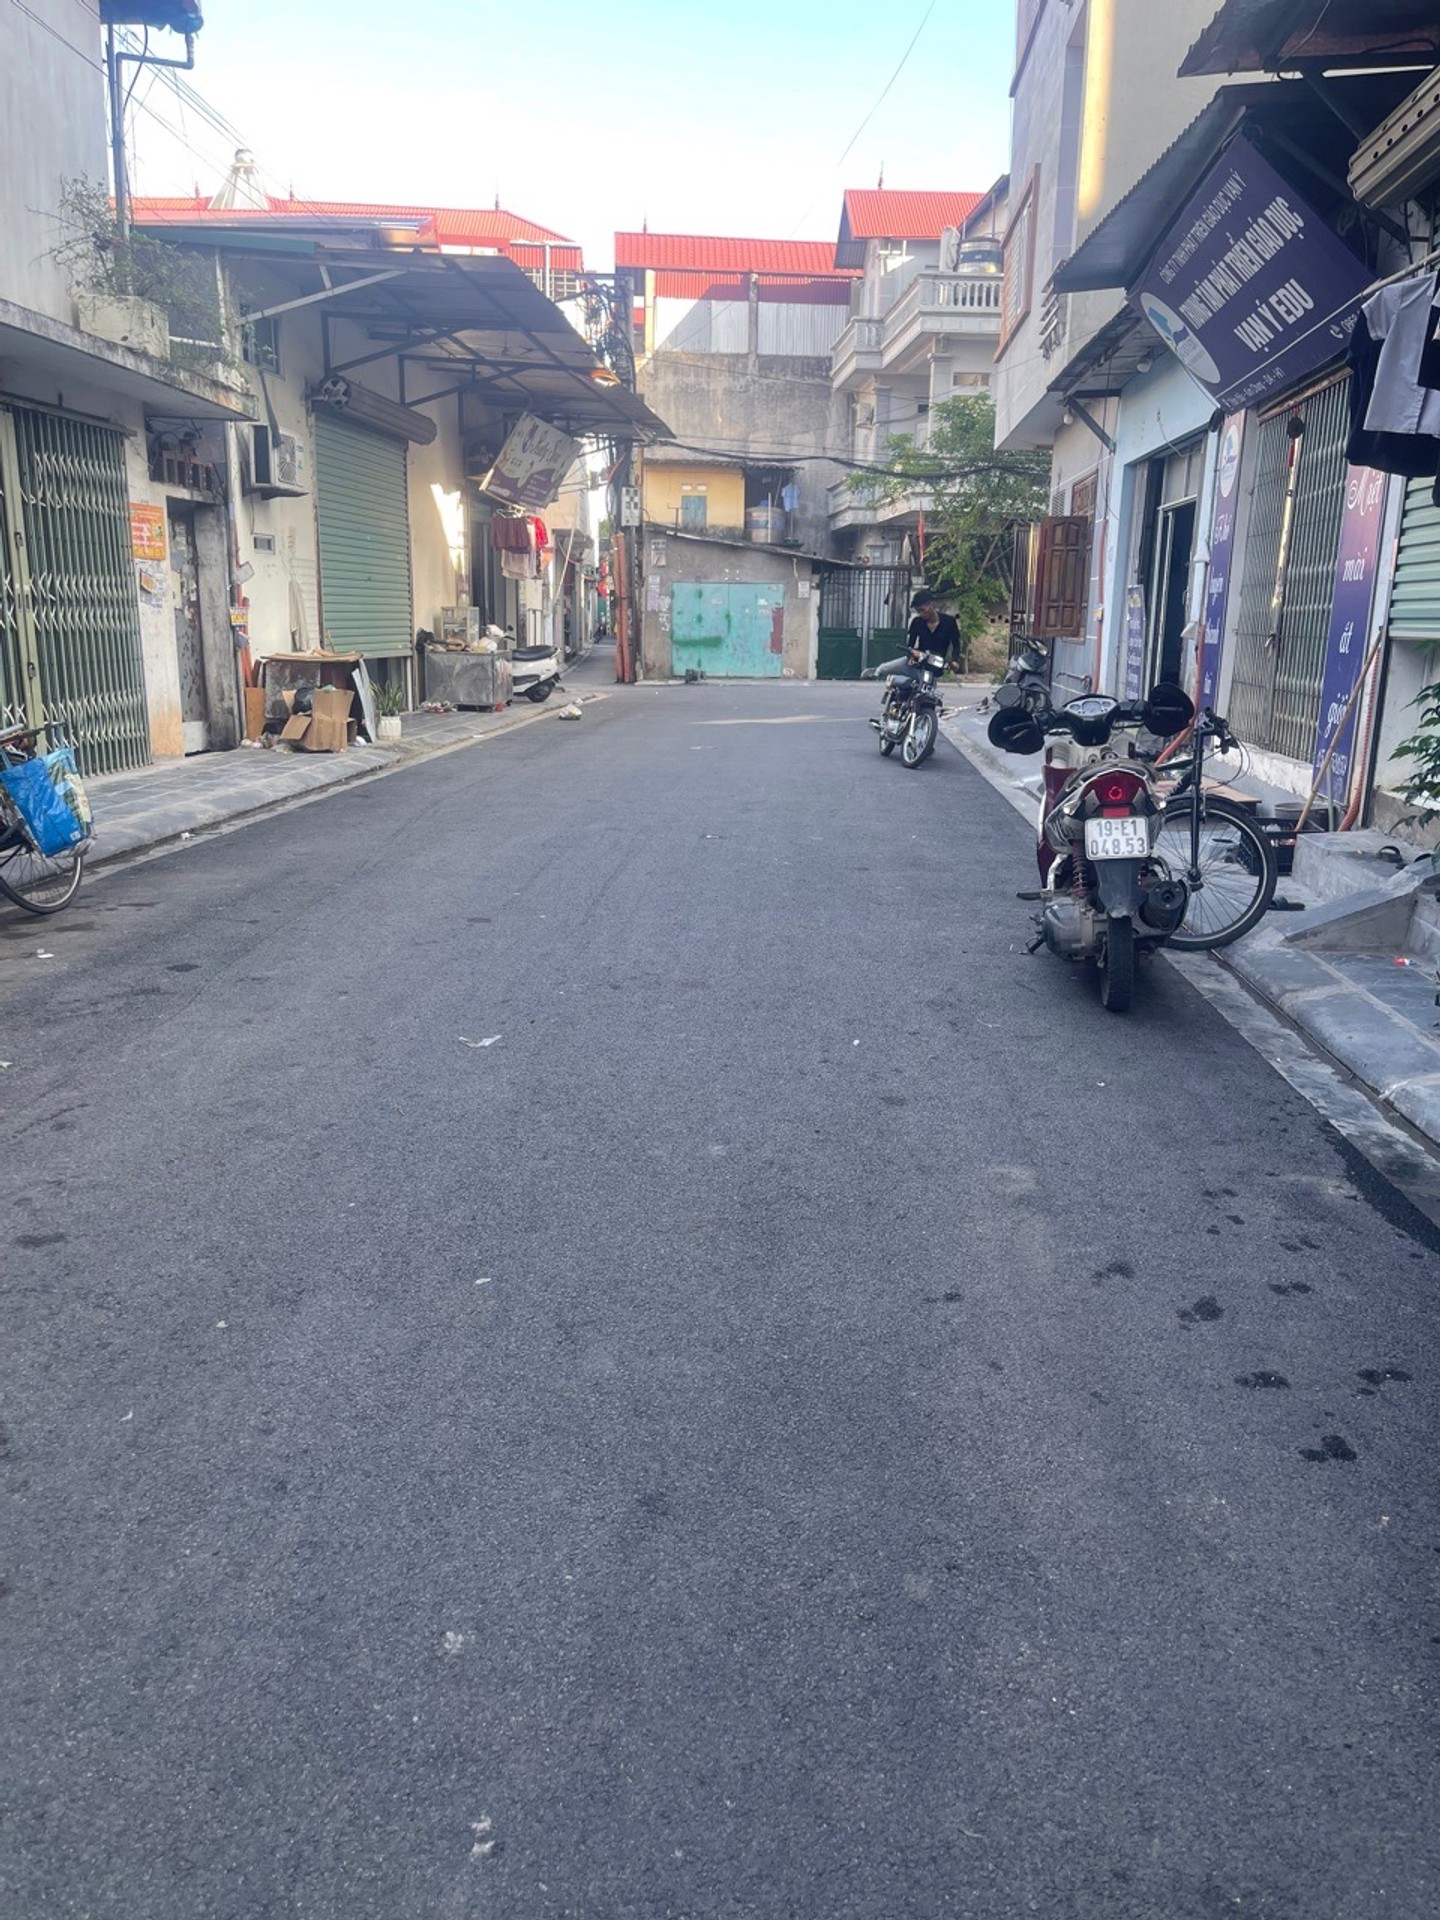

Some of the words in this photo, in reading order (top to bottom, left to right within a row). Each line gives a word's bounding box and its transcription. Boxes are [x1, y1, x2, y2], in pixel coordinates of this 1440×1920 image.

[1221, 177, 1243, 200] VẠN
[1230, 168, 1246, 187] Ý
[1201, 205, 1221, 228] GIÁO
[1211, 191, 1232, 215] DỤC
[1263, 196, 1304, 240] DỤC
[1245, 216, 1285, 261] GIÁO
[1223, 231, 1265, 282] TRIỂN
[1194, 279, 1227, 313] TÂM
[1207, 259, 1243, 301] PHÁT
[1179, 293, 1213, 330] TRUNG
[1255, 298, 1284, 333] Ý
[1268, 277, 1315, 325] EDU
[1233, 312, 1275, 352] VẠN
[1342, 547, 1368, 582] mài
[1090, 837, 1146, 856] 048.53
[1096, 820, 1137, 838] 19-E1
